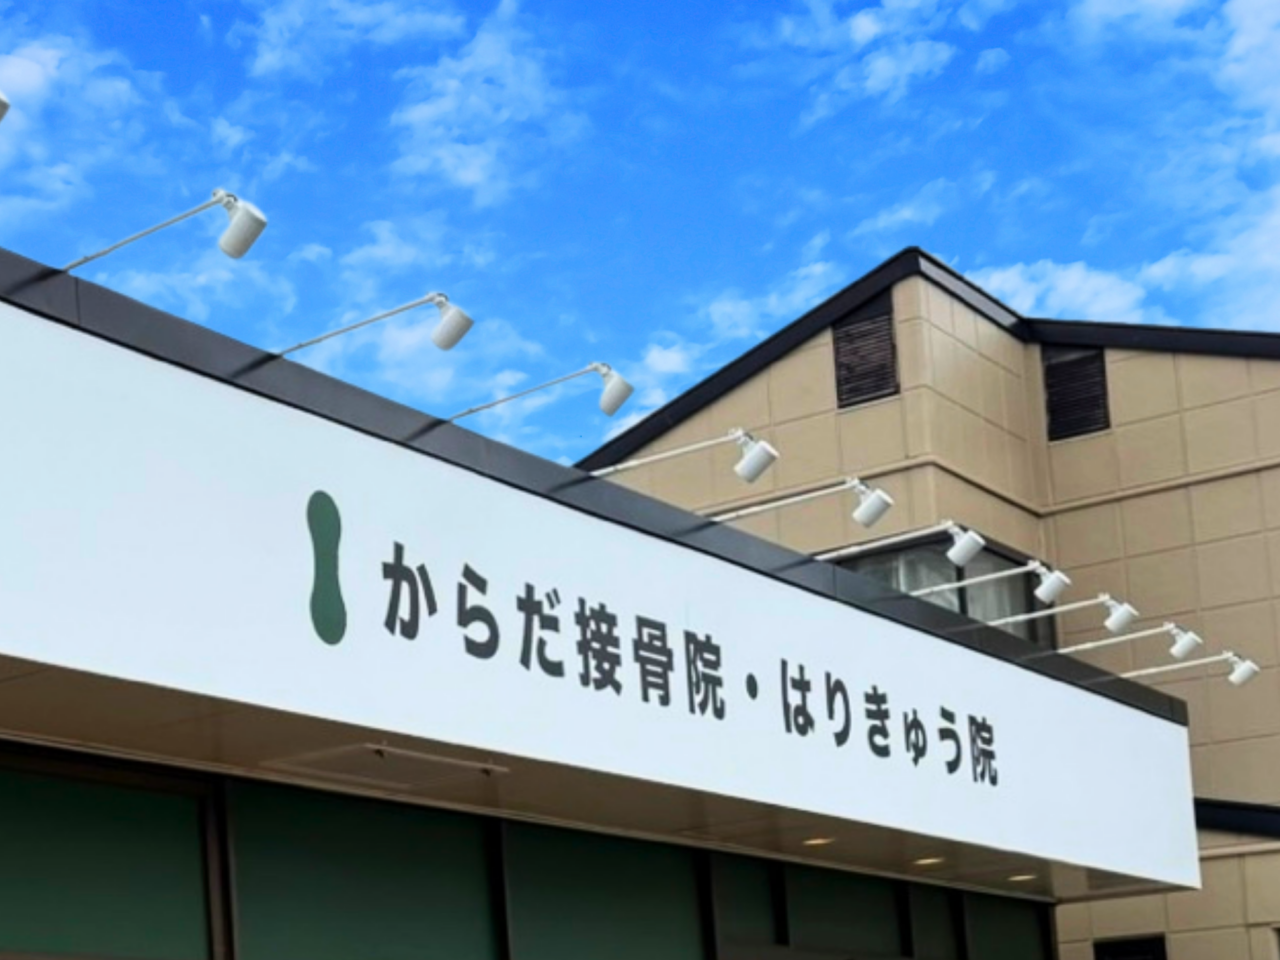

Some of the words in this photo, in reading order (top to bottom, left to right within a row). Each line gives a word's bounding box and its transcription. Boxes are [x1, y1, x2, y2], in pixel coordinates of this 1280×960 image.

[381, 540, 999, 787] からだ接骨院・はりきゅう院
